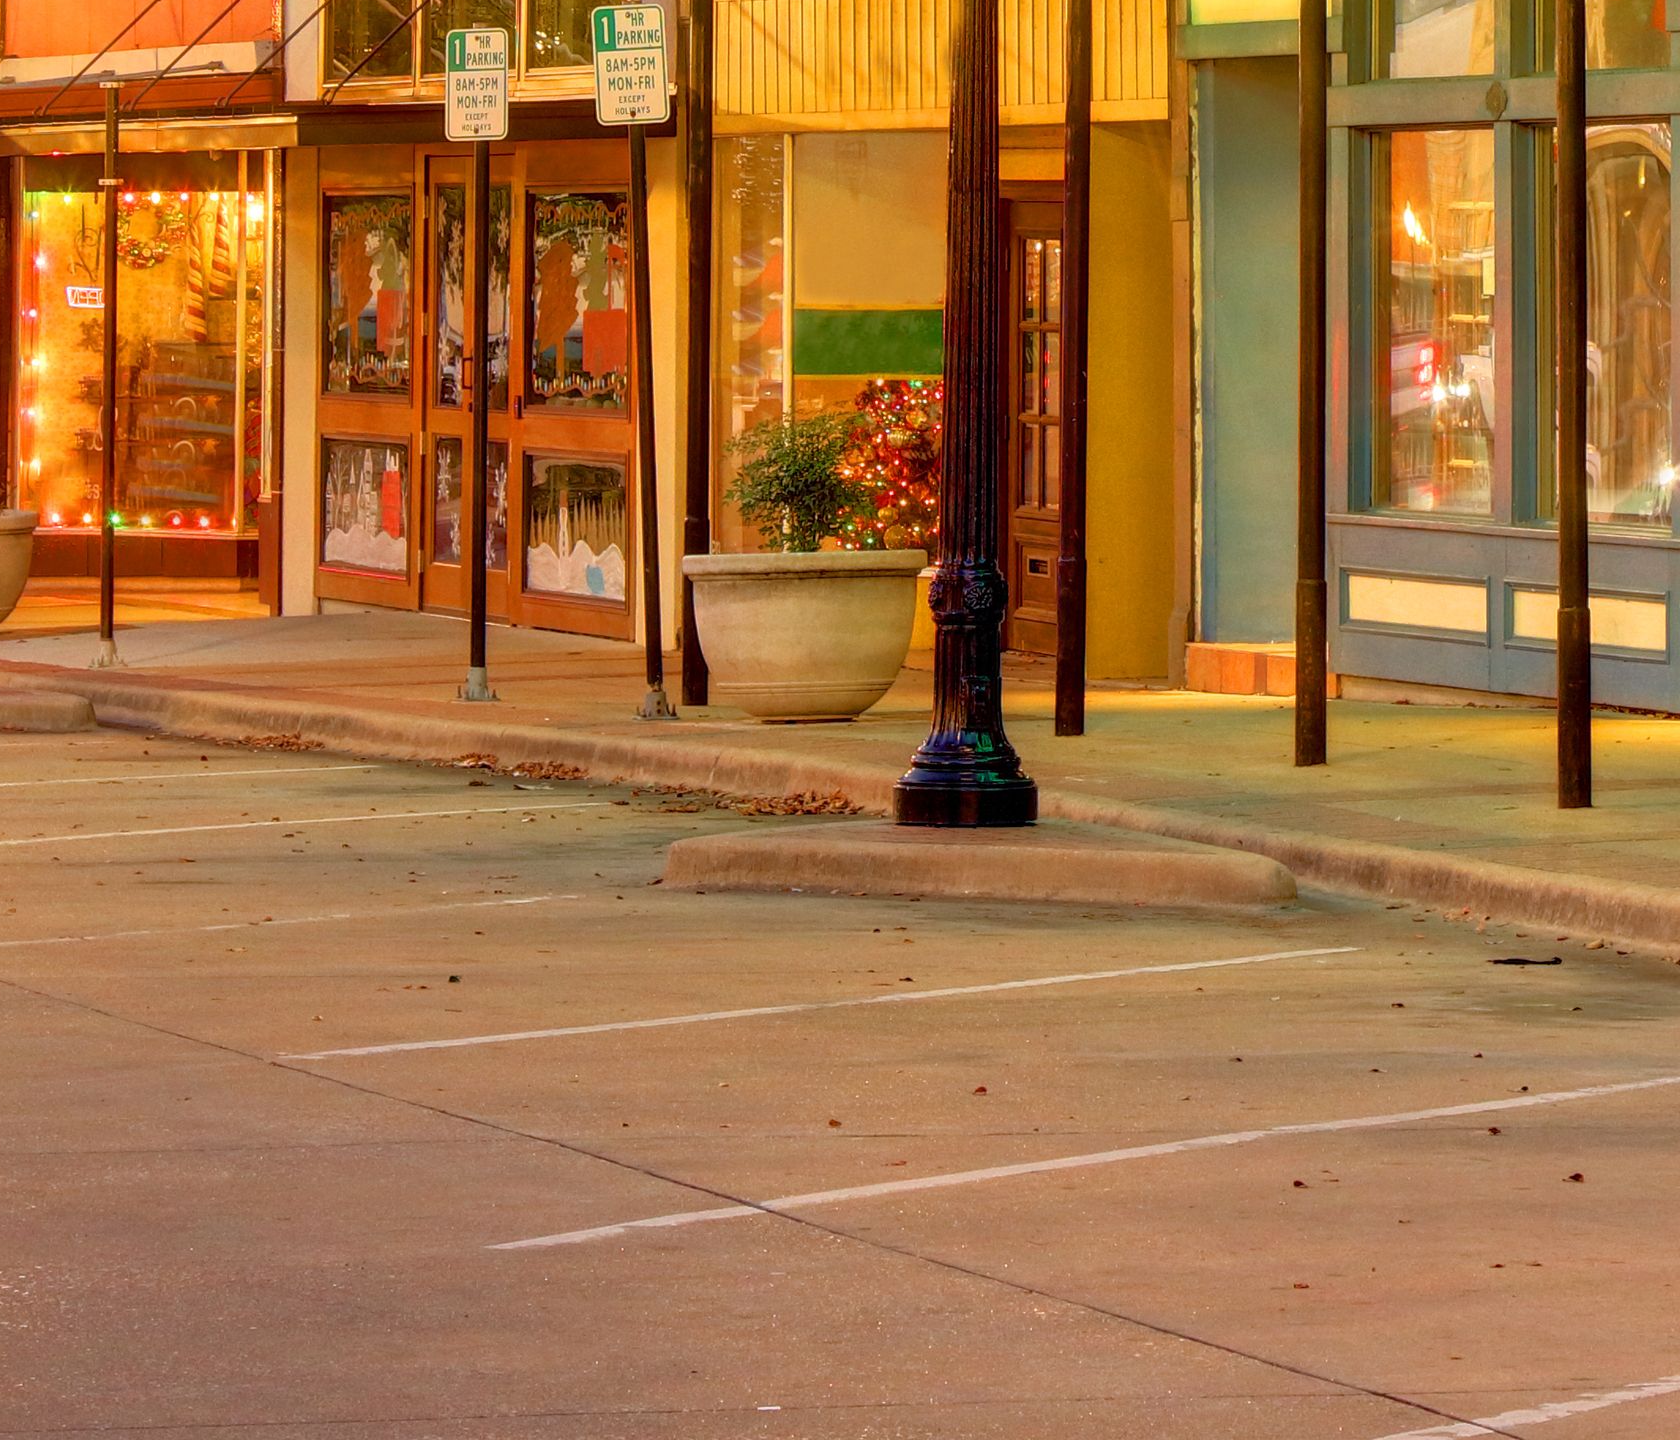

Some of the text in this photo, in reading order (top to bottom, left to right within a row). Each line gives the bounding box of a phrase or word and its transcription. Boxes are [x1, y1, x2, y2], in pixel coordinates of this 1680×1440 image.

[630, 12, 644, 27] HR
[601, 16, 609, 44] 1
[617, 29, 660, 45] PARKING
[479, 35, 491, 49] HR
[454, 38, 461, 65] 1
[466, 52, 504, 66] PARKING
[605, 56, 656, 73] 8AM-5PM
[455, 77, 499, 92] 8AM-5PM
[608, 75, 655, 91] MON-FRI
[457, 95, 497, 110] MON-FRI
[619, 94, 645, 104] EXCEPT
[465, 113, 489, 121] EXCEPT
